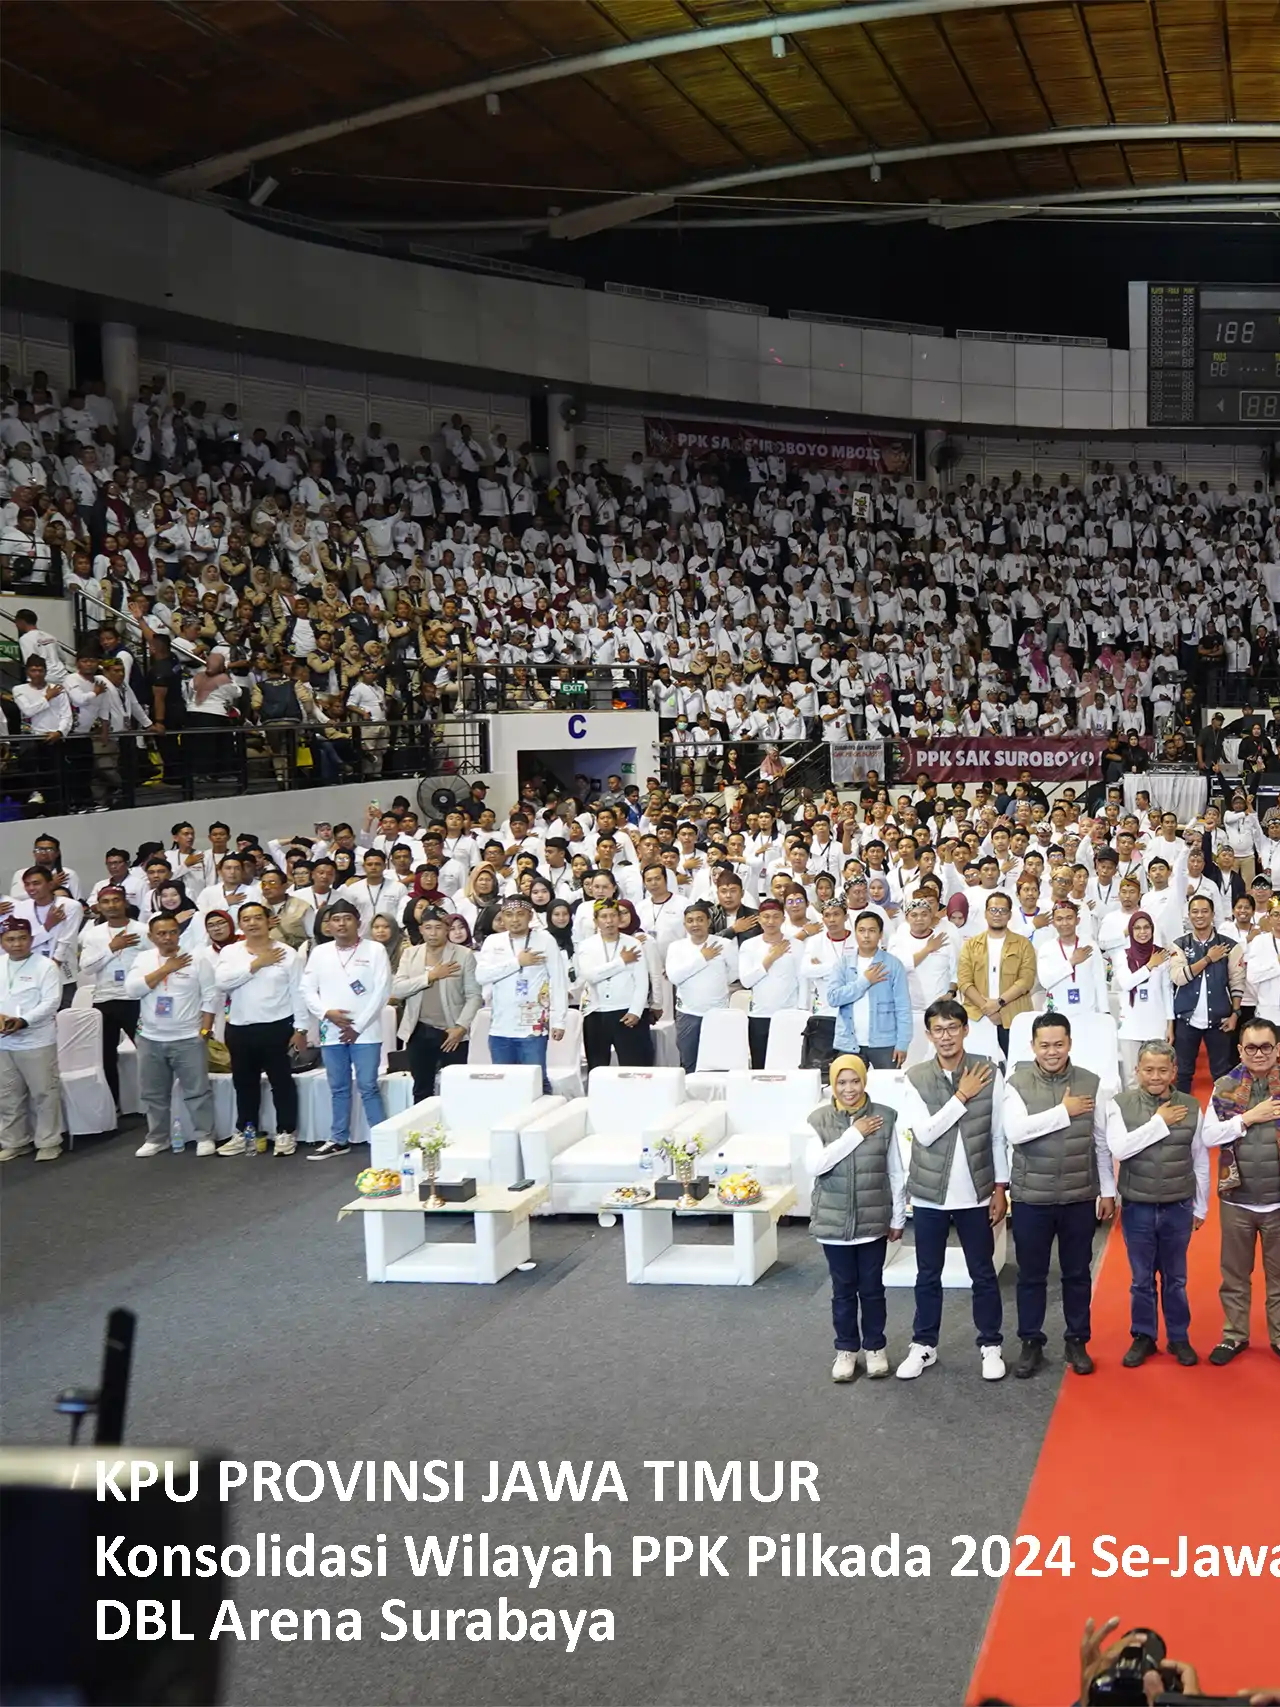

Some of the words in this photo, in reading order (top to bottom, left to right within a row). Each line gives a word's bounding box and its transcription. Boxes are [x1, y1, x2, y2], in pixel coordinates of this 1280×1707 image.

[1216, 321, 1255, 344] 188
[677, 432, 709, 448] PPK
[711, 435, 738, 451] SA
[831, 445, 881, 460] MBOIS
[562, 684, 583, 692] EXIT
[568, 714, 587, 739] C
[916, 750, 952, 767] PPK
[955, 750, 991, 767] SAK
[994, 750, 1094, 767] SUROBOYO
